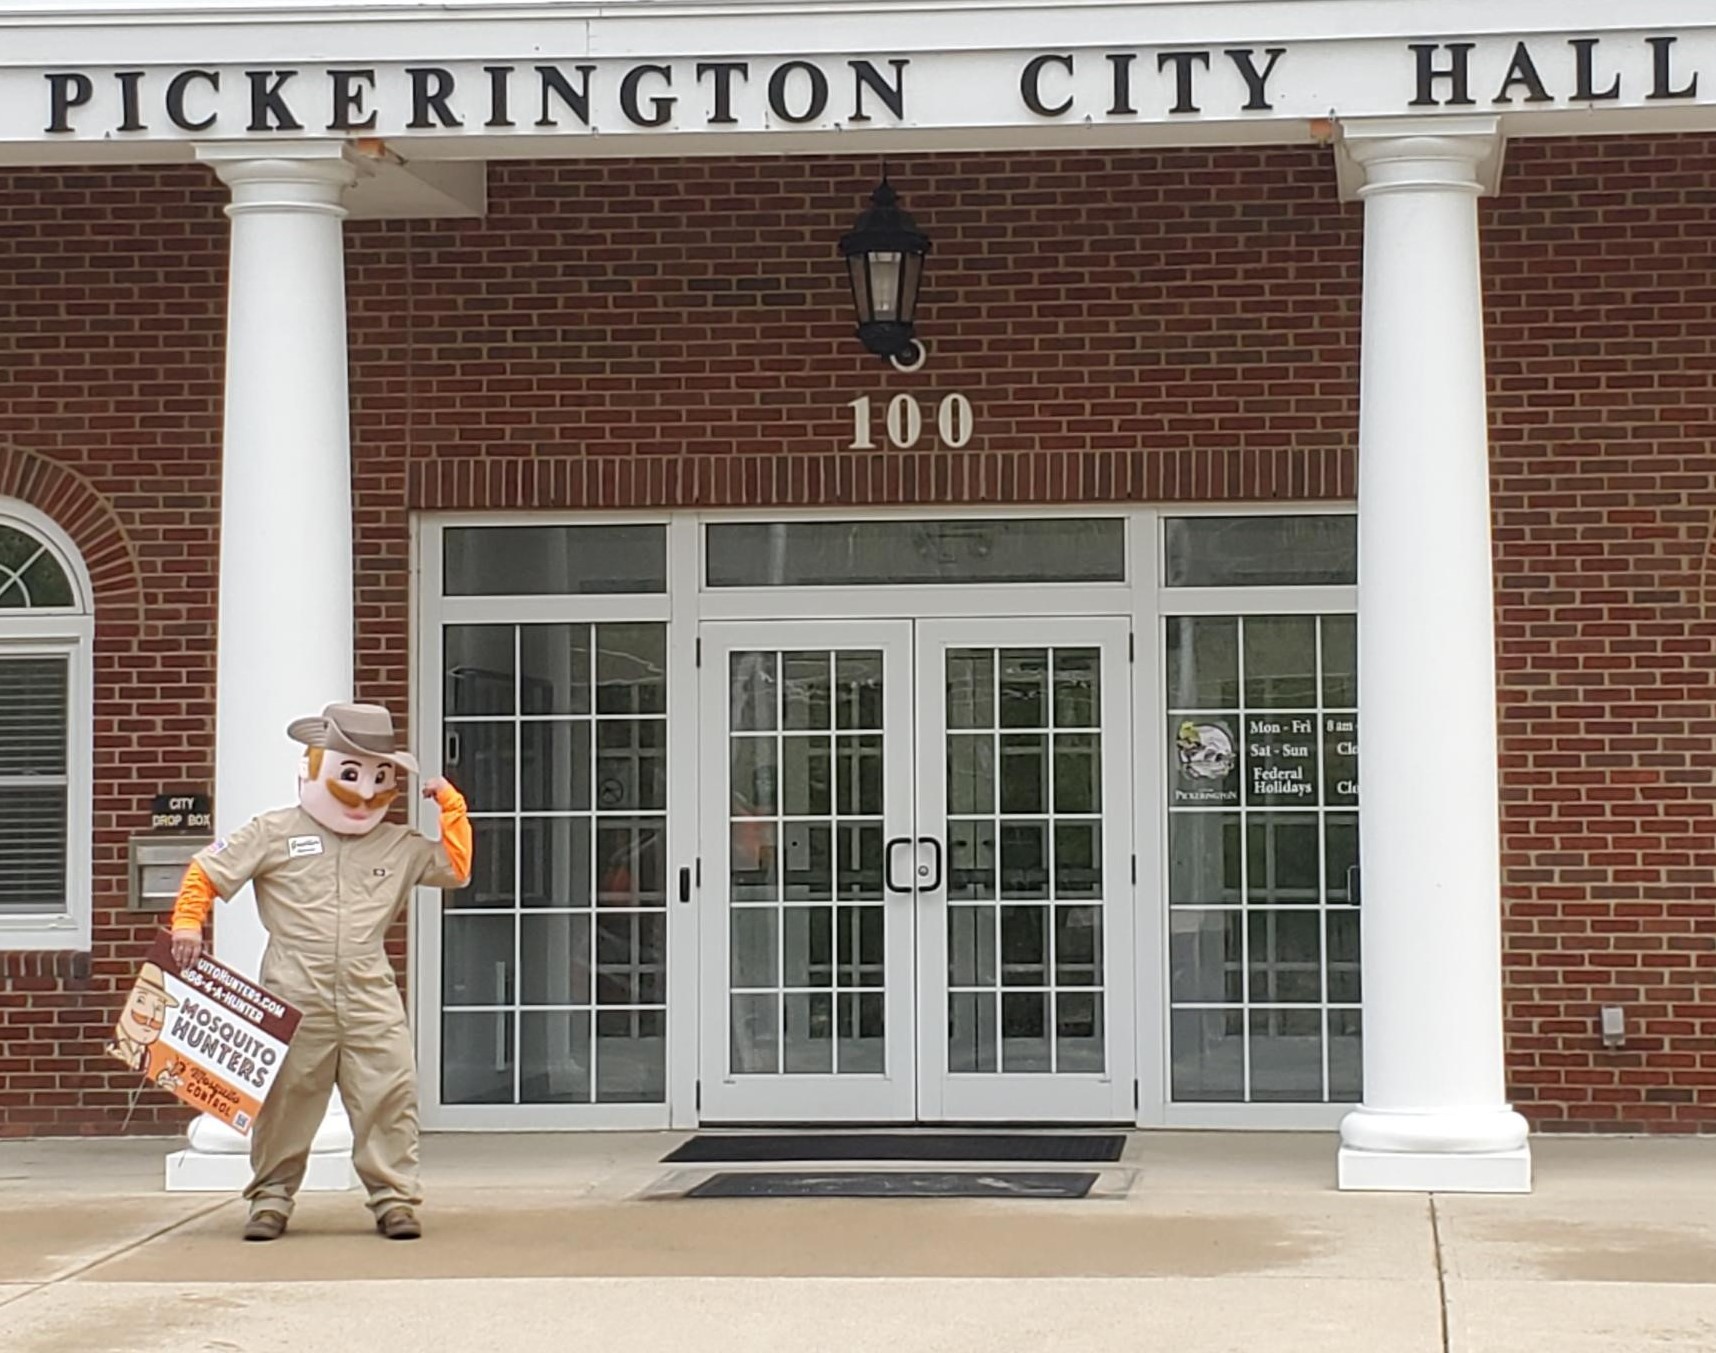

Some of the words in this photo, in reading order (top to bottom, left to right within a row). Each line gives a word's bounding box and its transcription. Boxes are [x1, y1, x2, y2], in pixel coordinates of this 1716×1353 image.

[44, 58, 911, 134] PICKERINGTON
[1020, 48, 1287, 117] CITY
[1408, 36, 1699, 107] HALL
[847, 393, 974, 449] 100
[1250, 720, 1281, 734] Mon
[1292, 719, 1312, 733] Fri
[1250, 744, 1271, 757] Sat
[1282, 744, 1308, 757] Sun
[1253, 766, 1303, 780] Federal
[1253, 780, 1312, 797] Holidays
[169, 797, 195, 810] CITY
[152, 814, 182, 827] DROP
[188, 814, 211, 828] BOX
[180, 998, 277, 1066] MOSQUITO
[171, 1016, 270, 1088] HUNTERS
[186, 1083, 232, 1116] CONTROL
